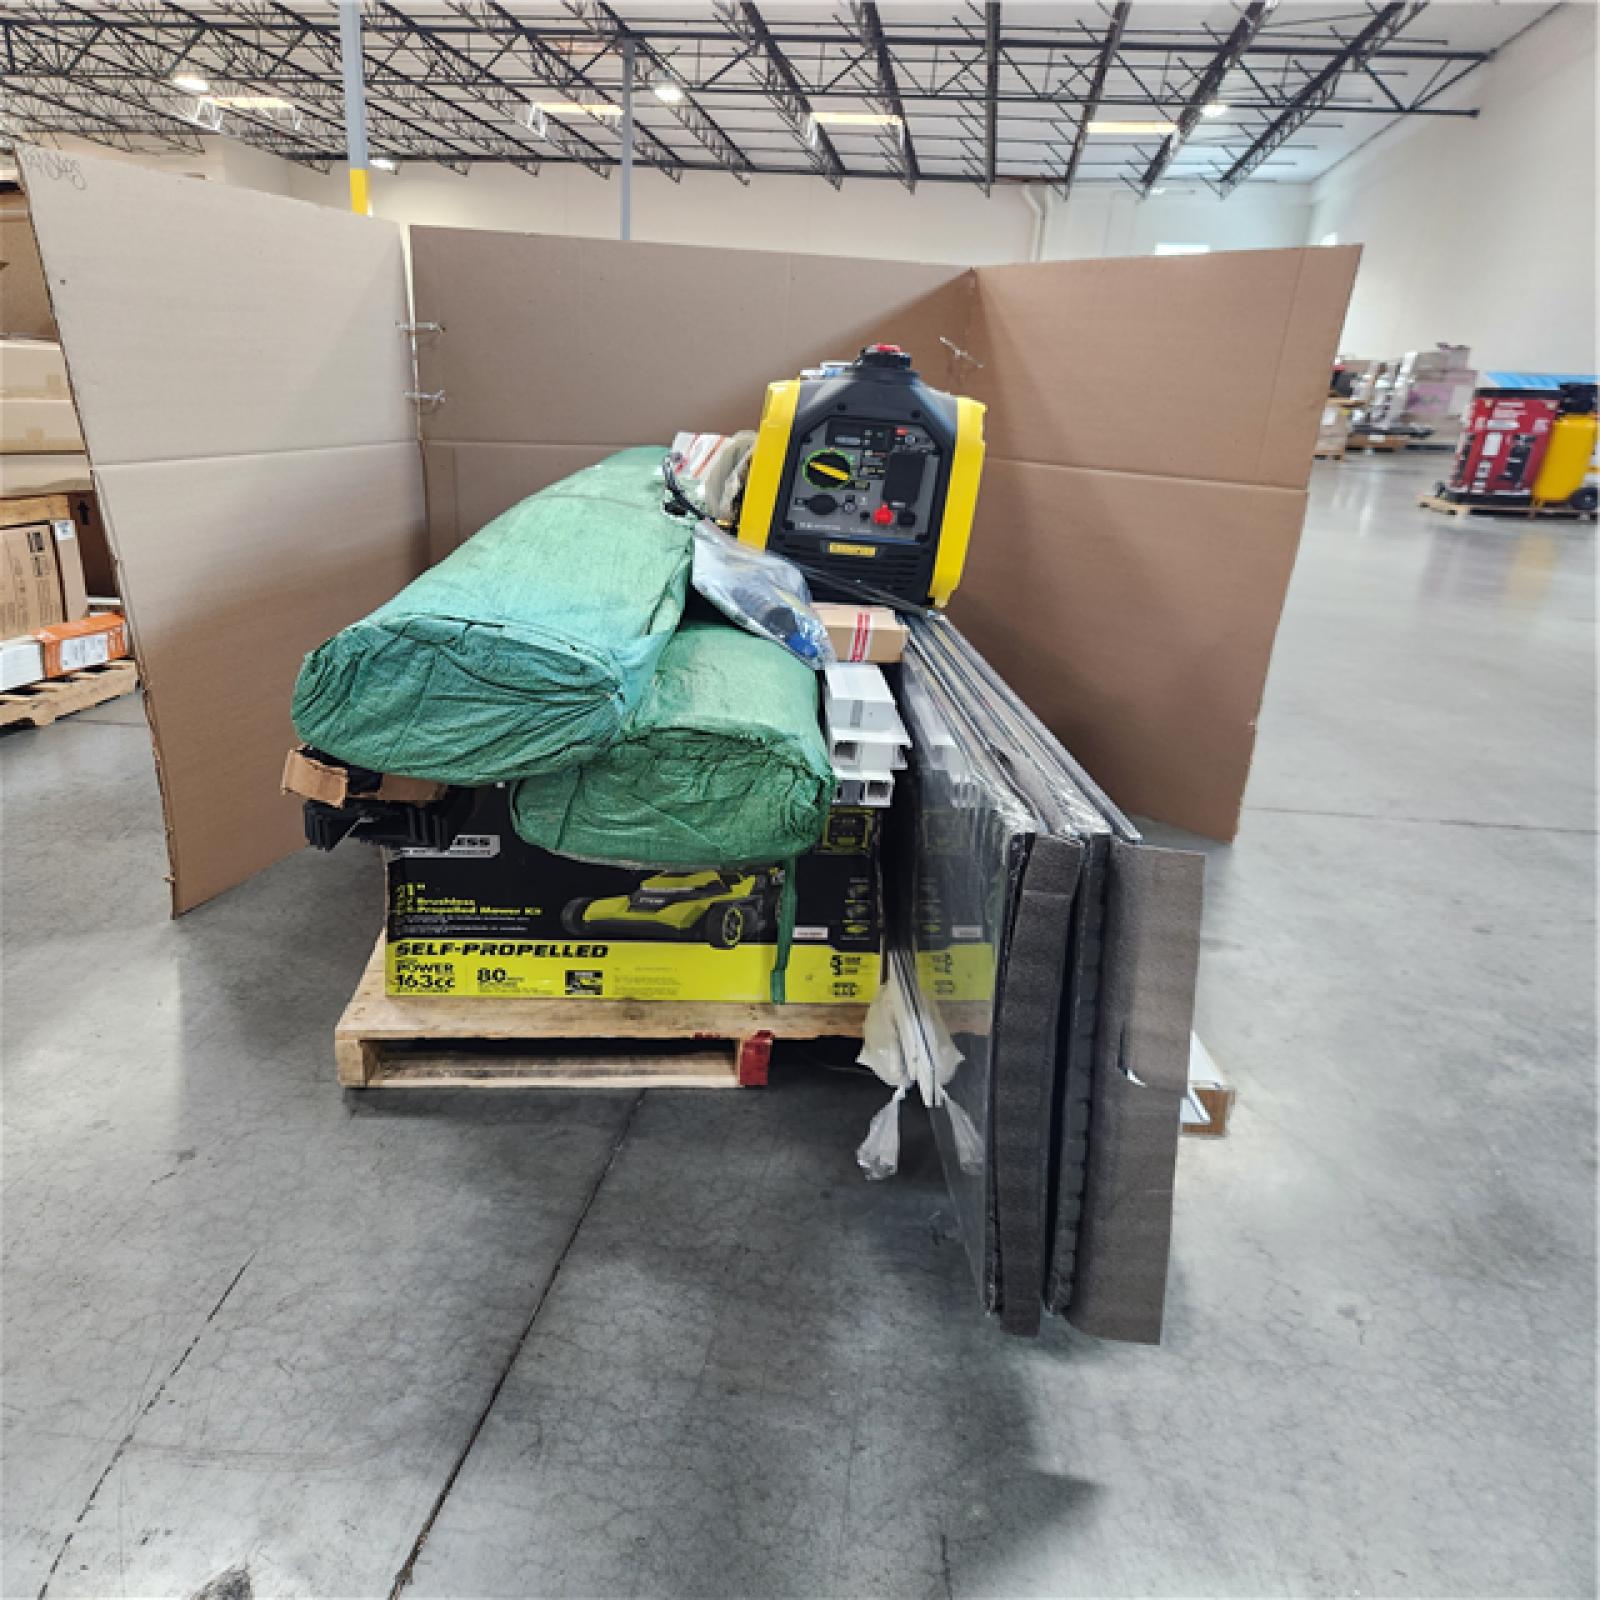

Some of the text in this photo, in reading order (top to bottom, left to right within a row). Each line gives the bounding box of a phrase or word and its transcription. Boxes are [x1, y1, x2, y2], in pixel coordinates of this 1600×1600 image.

[396, 942, 609, 958] SELF-PROPELLED
[396, 962, 454, 974] POWER
[477, 967, 506, 982] 80
[396, 974, 456, 988] 163cc
